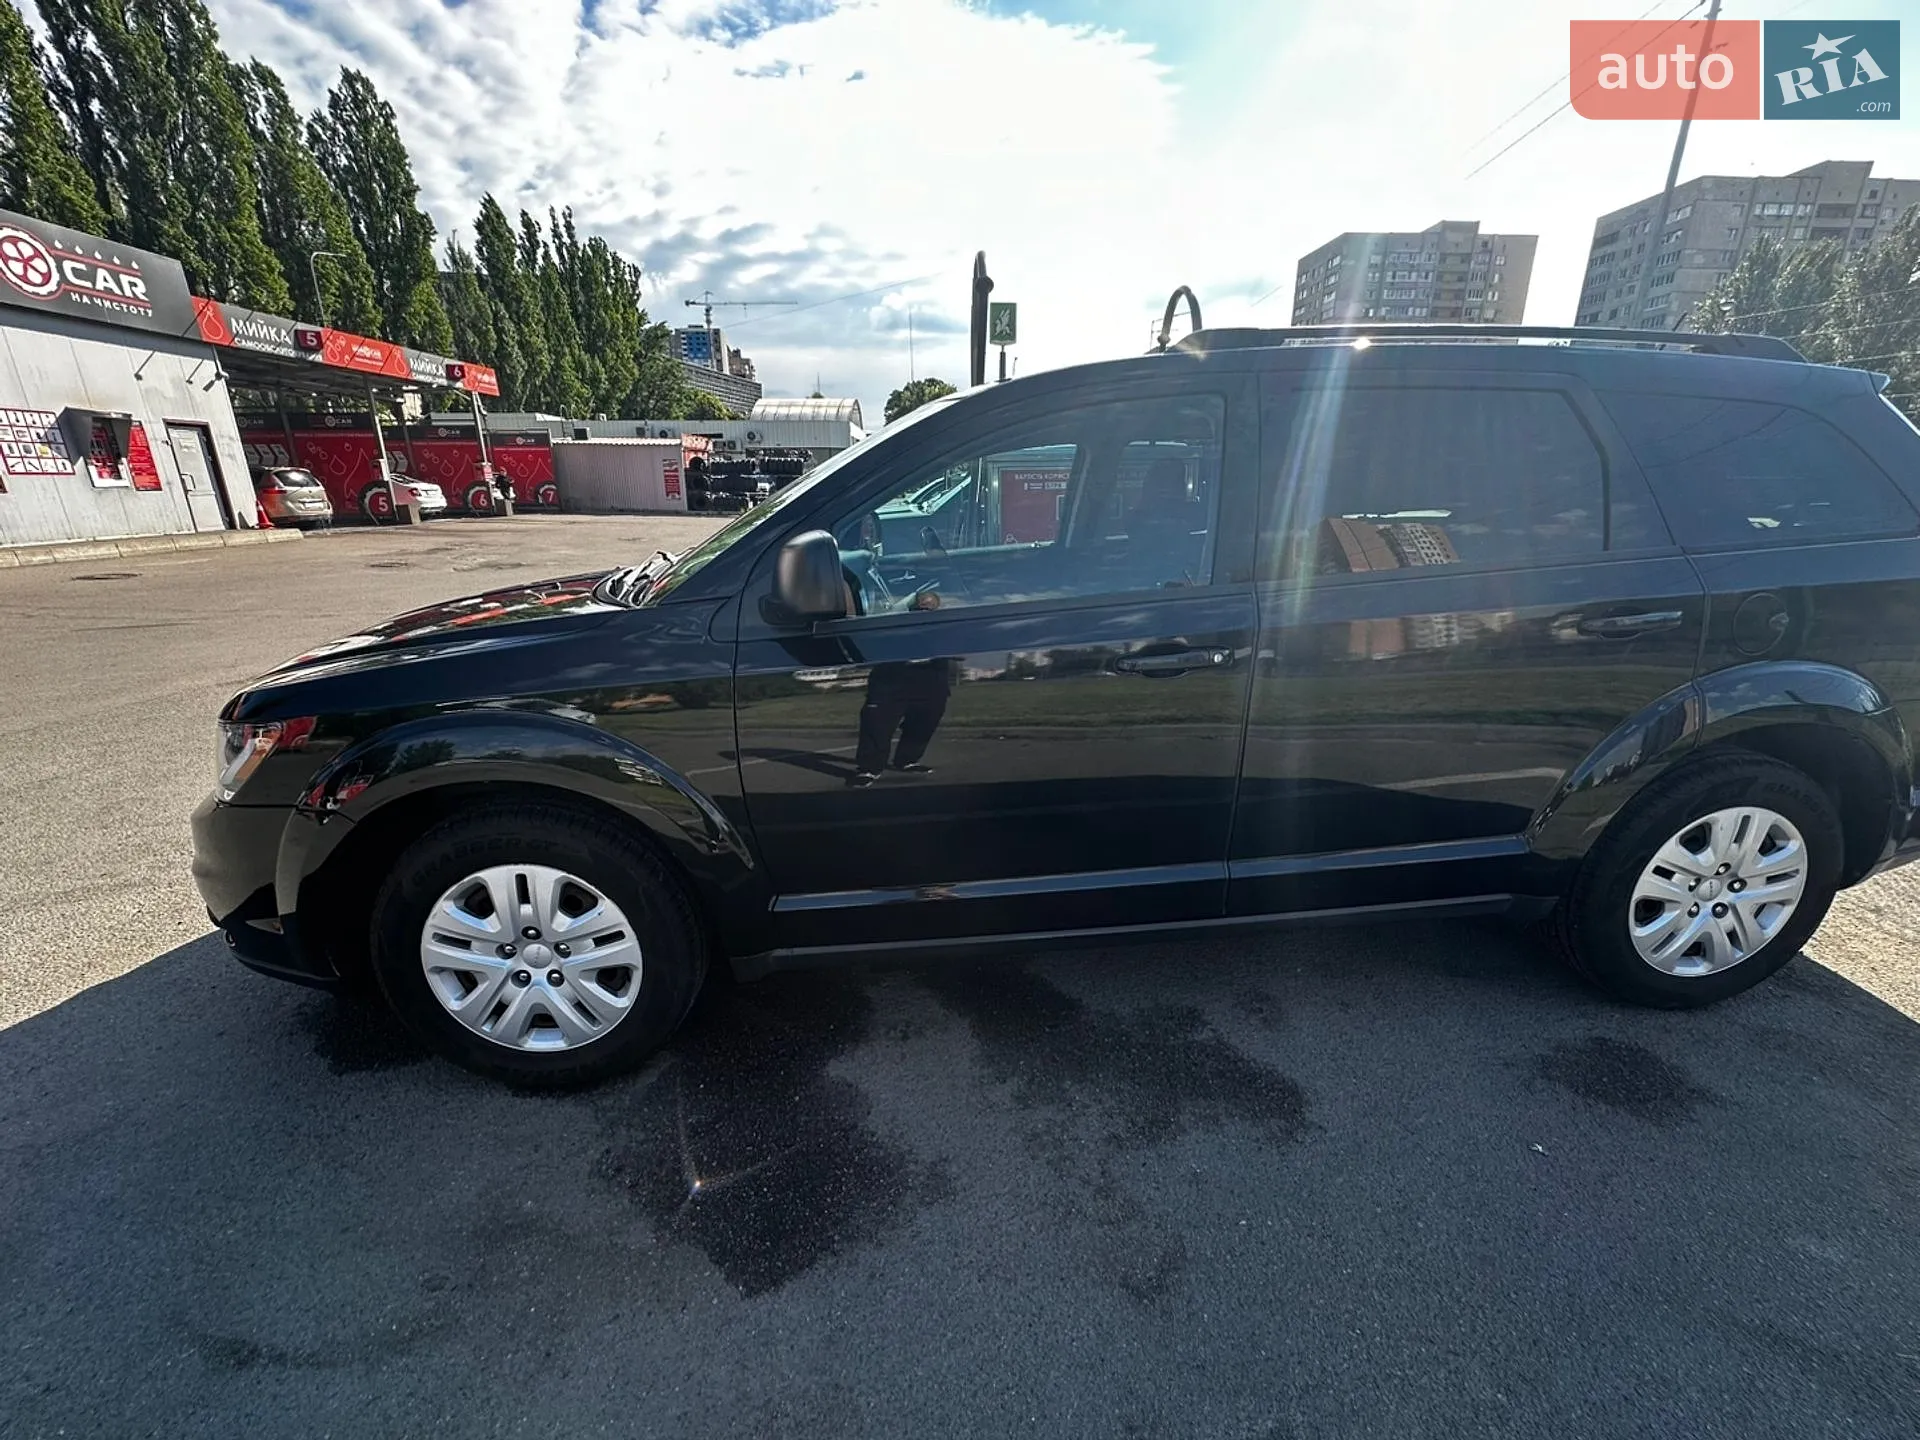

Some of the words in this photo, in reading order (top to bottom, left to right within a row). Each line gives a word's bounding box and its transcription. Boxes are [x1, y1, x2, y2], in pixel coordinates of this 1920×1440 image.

[62, 259, 150, 302] CAR
[70, 291, 91, 305] НА
[93, 296, 153, 317] ЧИСТОТУ
[230, 316, 292, 345] МИЙКА
[305, 331, 318, 346] 5
[454, 365, 463, 378] 6
[377, 496, 389, 512] 5
[478, 493, 488, 507] 6
[546, 490, 555, 503] 7
